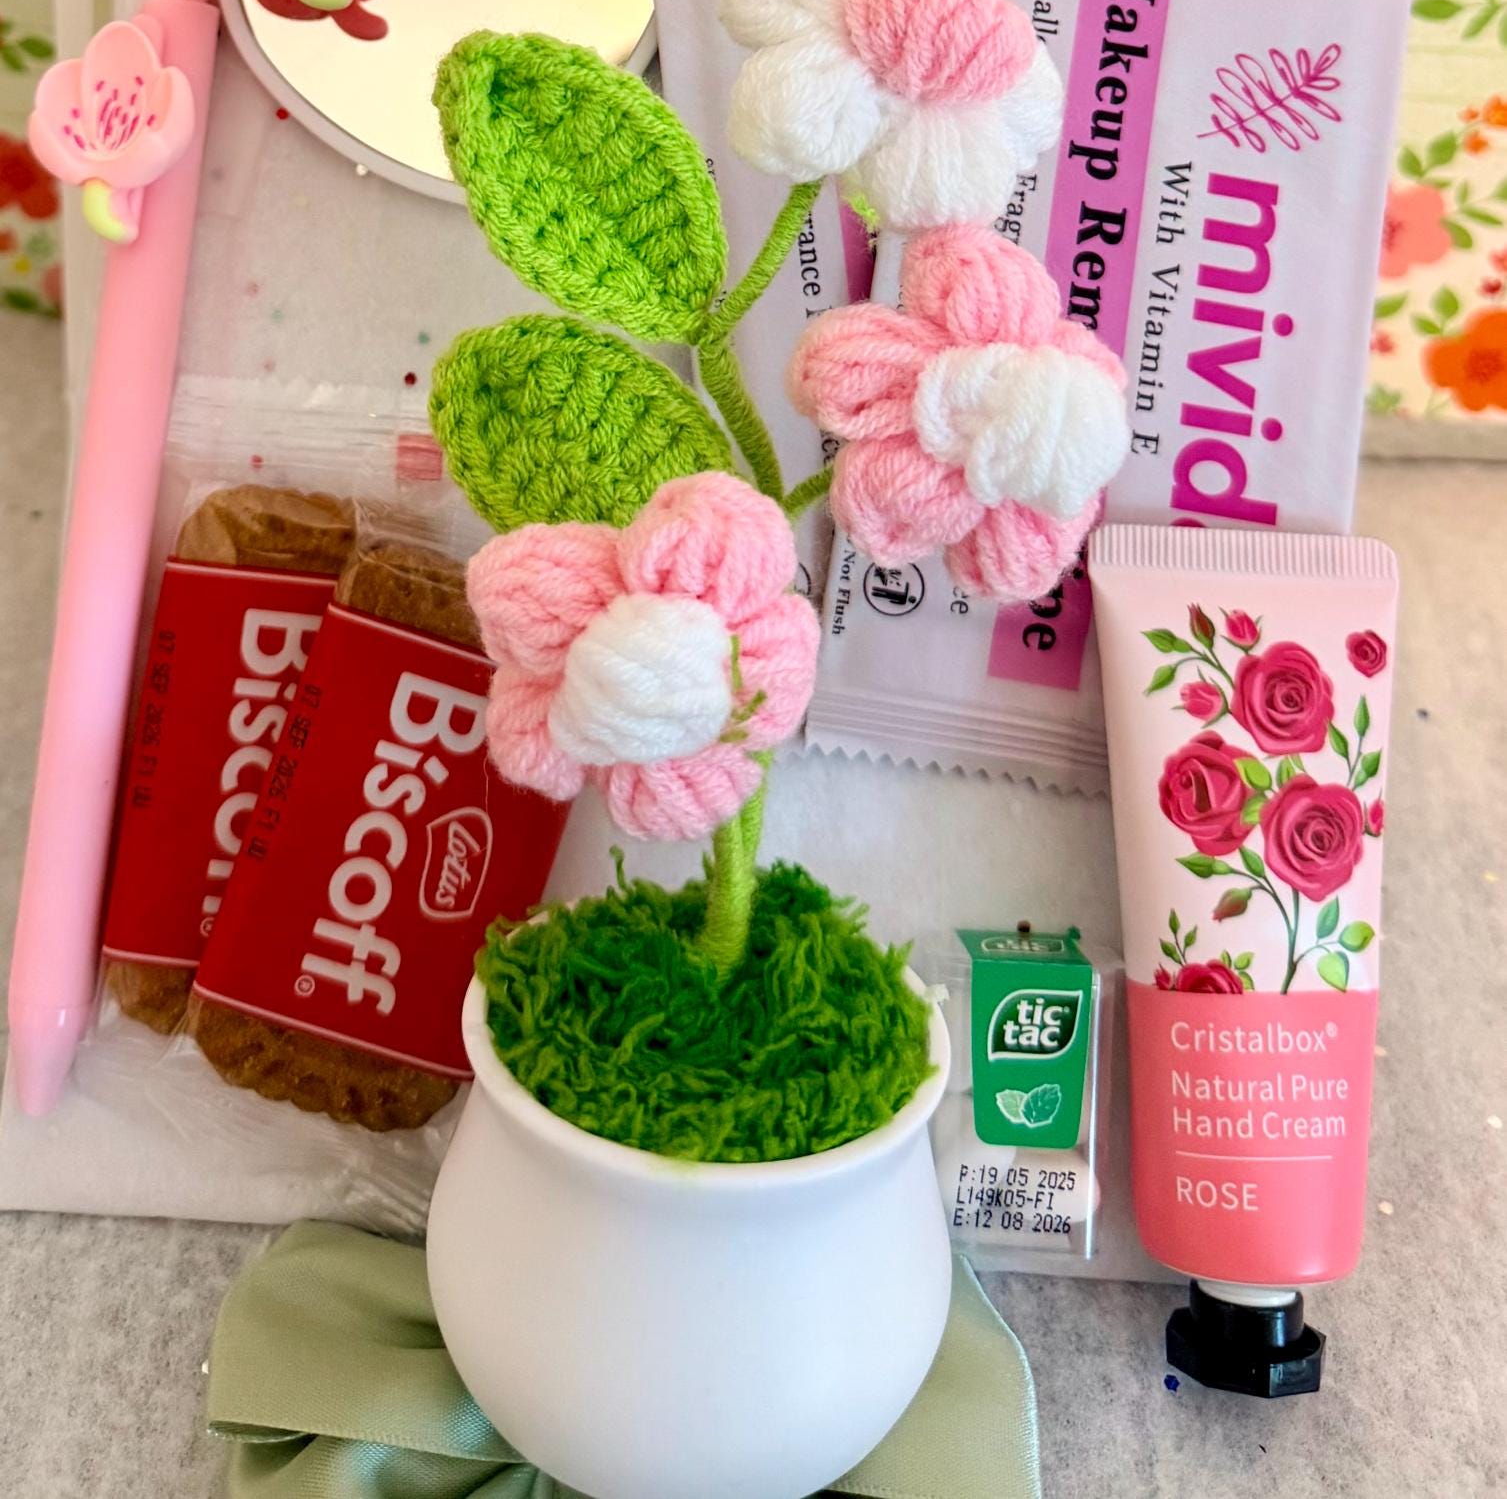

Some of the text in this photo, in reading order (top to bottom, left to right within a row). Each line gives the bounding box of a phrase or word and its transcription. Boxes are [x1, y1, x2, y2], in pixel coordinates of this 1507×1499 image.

[1067, 200, 1127, 332] Rem
[1130, 161, 1192, 455] With Vitamin E
[1169, 172, 1294, 528] mivid
[831, 589, 851, 636] Flush
[1016, 997, 1062, 1027] tic
[1003, 1020, 1061, 1048] tac
[1171, 1070, 1349, 1101] Natural Pure
[1172, 1107, 1346, 1140] Hand Cream
[1006, 1167, 1029, 1187] 05
[1038, 1170, 1077, 1191] 2025
[1176, 1175, 1260, 1211] ROSE
[953, 1208, 1071, 1234] E:12 08 2026
